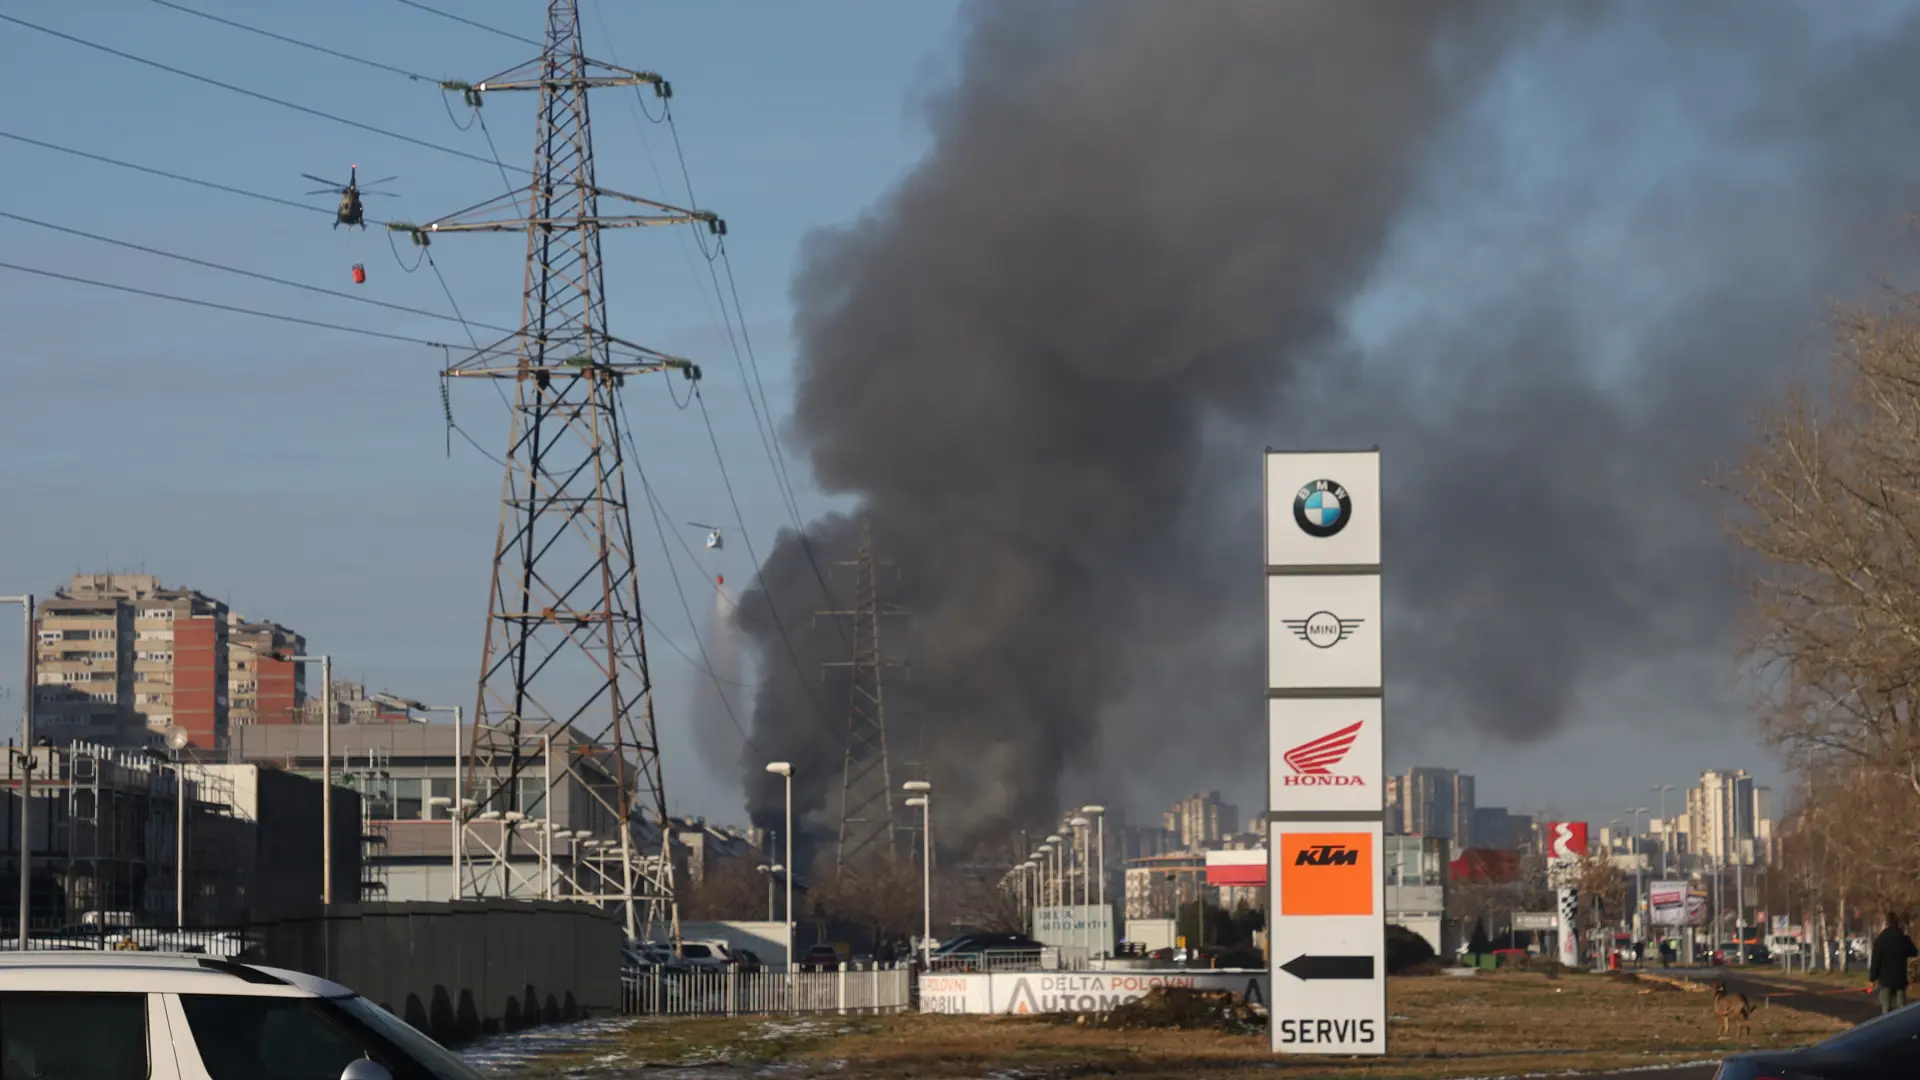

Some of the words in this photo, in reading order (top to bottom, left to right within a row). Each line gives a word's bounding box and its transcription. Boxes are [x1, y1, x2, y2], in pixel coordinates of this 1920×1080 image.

[1299, 480, 1347, 500] BMW
[1309, 625, 1337, 635] MINI
[1283, 775, 1365, 786] HONDA
[1294, 845, 1358, 866] KTM
[1041, 976, 1105, 991] DELTA
[1281, 1019, 1374, 1043] SERVIS
